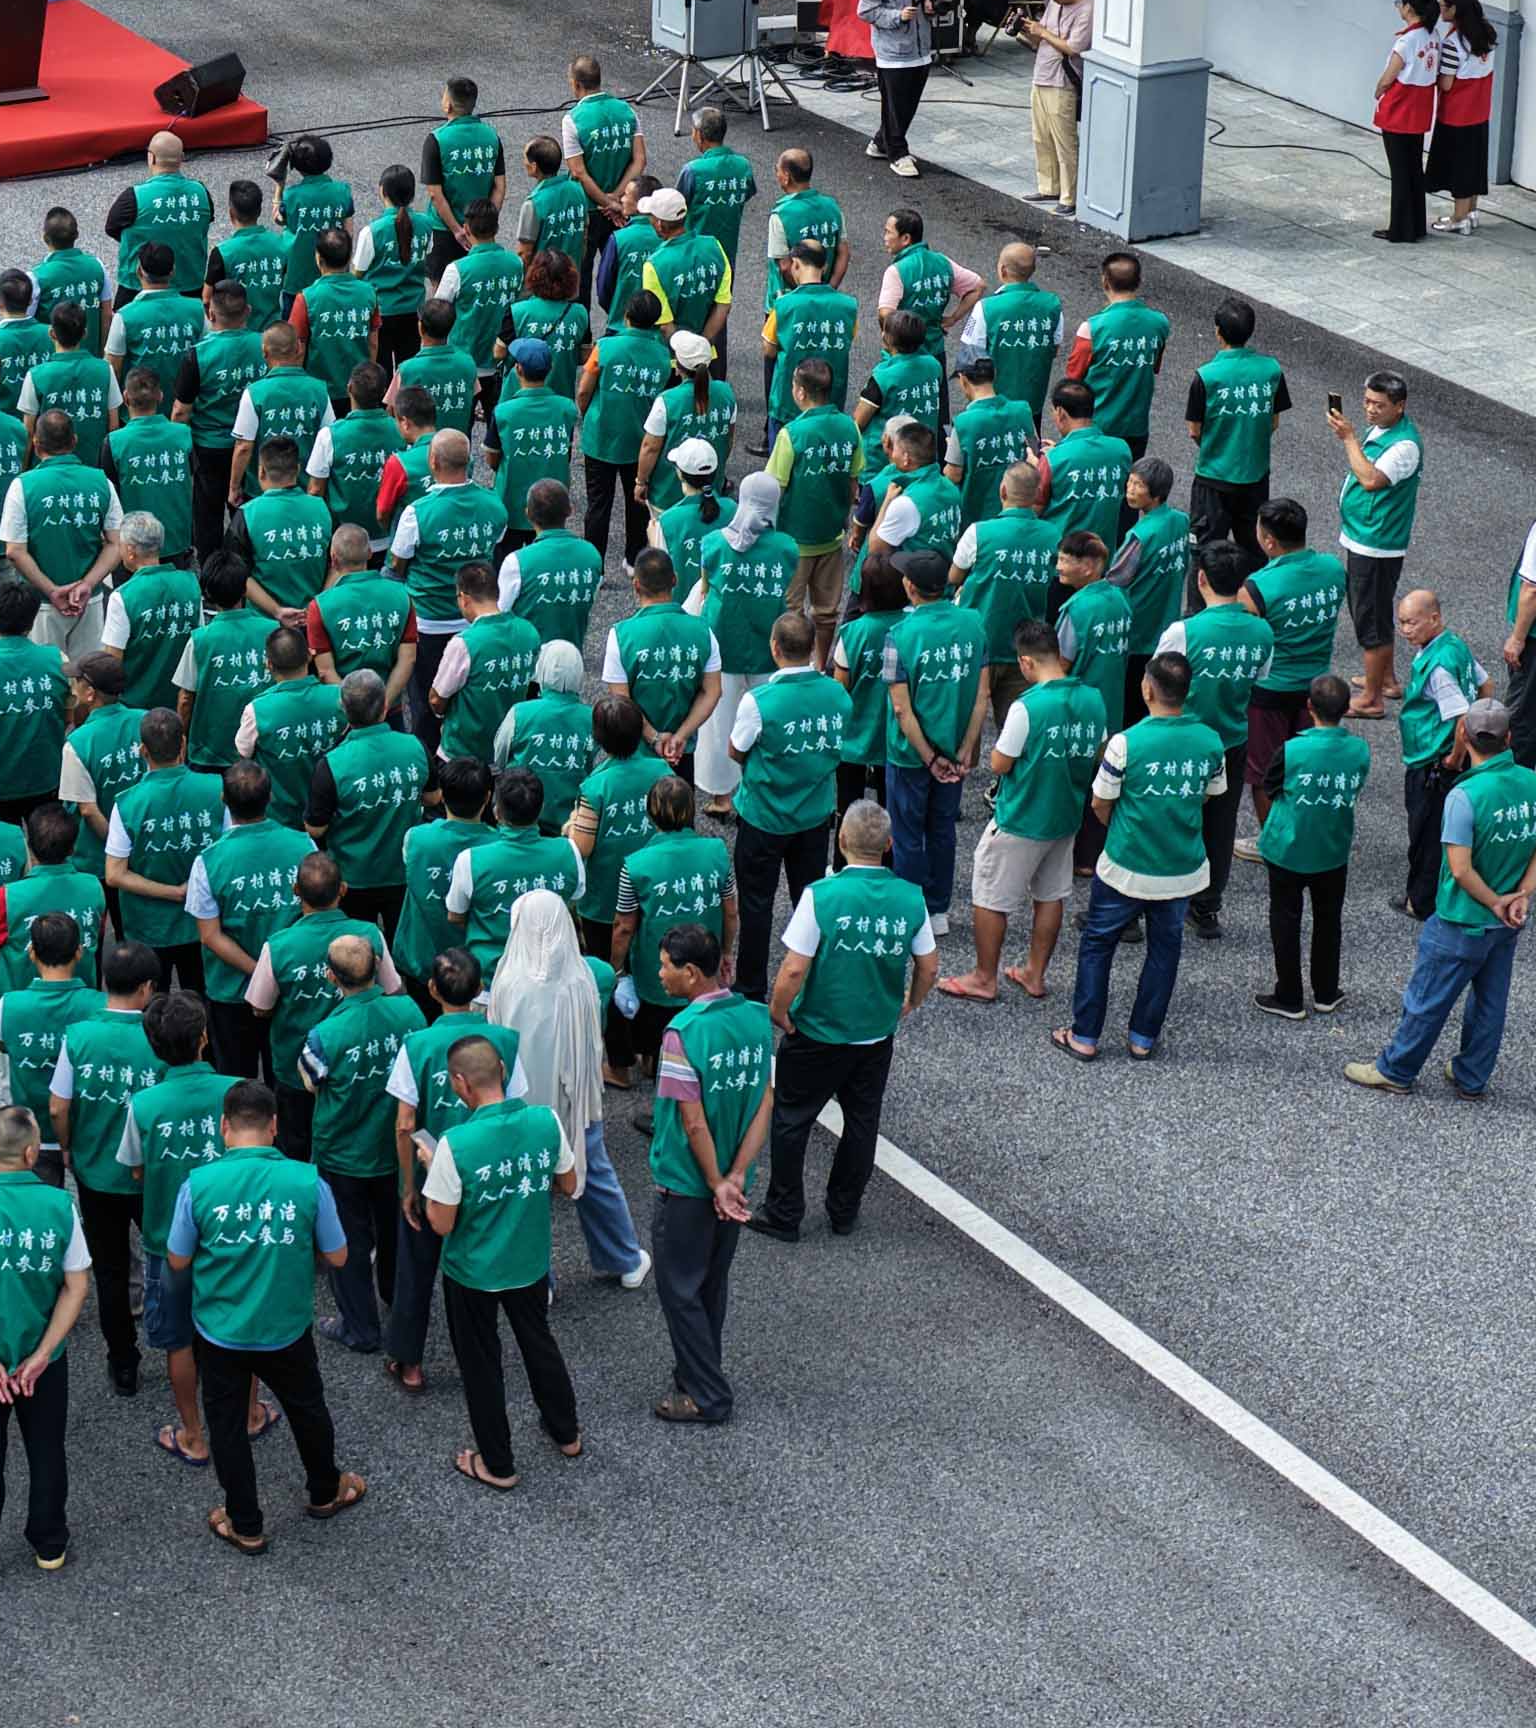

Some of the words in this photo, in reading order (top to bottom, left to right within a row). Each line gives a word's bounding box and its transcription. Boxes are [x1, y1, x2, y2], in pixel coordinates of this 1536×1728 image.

[449, 144, 494, 161] 万村清洁
[152, 193, 200, 209] 万村清洁
[151, 209, 201, 225] 人人参与
[234, 256, 283, 274] 万村清洁
[140, 322, 194, 340] 万村清洁
[792, 319, 846, 335] 万村清洁
[998, 316, 1053, 333] 万村清洁
[793, 336, 845, 352] 人人参与
[612, 364, 662, 384] 万村清洁
[46, 387, 103, 405] 万村清洁
[1216, 381, 1273, 401] 万村清洁
[512, 423, 570, 441] 万村清洁
[127, 449, 185, 469] 万村清洁
[513, 441, 573, 460] 人人参与
[803, 440, 854, 460] 万村清洁
[130, 468, 186, 485] 人人参与
[1066, 464, 1122, 484] 万村清洁
[40, 491, 100, 509] 万村清洁
[42, 511, 100, 529] 人人参与
[263, 522, 323, 544] 万村清洁
[436, 520, 494, 543] 万村清洁
[266, 543, 324, 561] 人人参与
[994, 548, 1053, 566] 万村清洁
[536, 567, 593, 587] 万村清洁
[719, 560, 784, 580] 万村清洁
[536, 587, 592, 606] 人人参与
[718, 580, 784, 598] 人人参与
[140, 601, 195, 623] 万村清洁
[336, 610, 401, 632] 万村清洁
[635, 643, 699, 663] 万村清洁
[1201, 644, 1263, 663] 万村清洁
[636, 664, 697, 683] 人人参与
[275, 716, 339, 741] 万村清洁
[782, 712, 844, 736] 万村清洁
[782, 735, 844, 754] 人人参与
[352, 763, 420, 793] 万村清洁
[357, 786, 420, 811] 人人参与
[142, 808, 212, 833] 万村清洁
[144, 831, 217, 853] 人人参与
[835, 914, 908, 937] 万村清洁
[834, 937, 904, 958] 人人参与
[76, 1062, 161, 1090] 万村清洁
[474, 1147, 551, 1182] 万村清洁
[477, 1174, 553, 1204] 人人参与
[211, 1199, 297, 1224] 万村清洁
[214, 1227, 296, 1247] 人人参与
